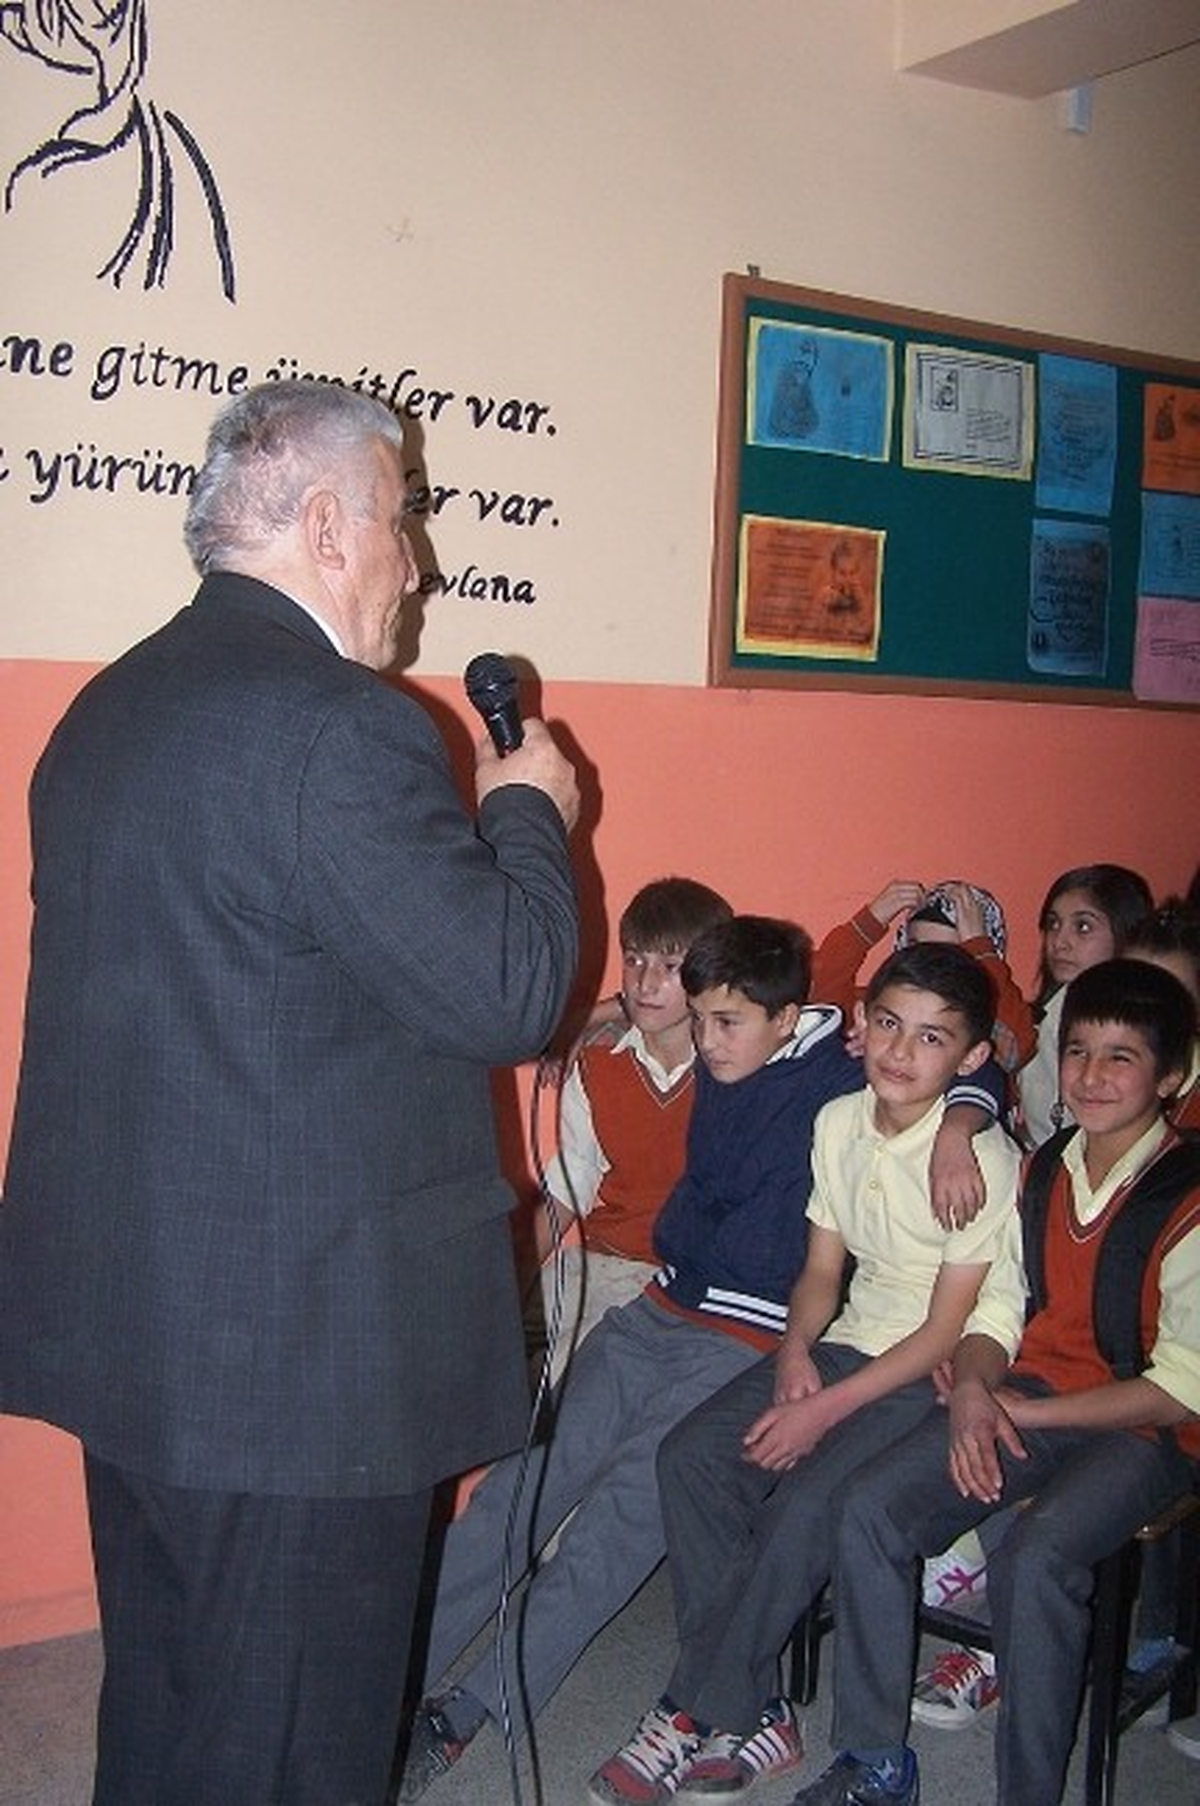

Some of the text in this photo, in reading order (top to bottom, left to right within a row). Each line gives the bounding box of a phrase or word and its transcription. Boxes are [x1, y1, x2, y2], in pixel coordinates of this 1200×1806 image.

[0, 336, 73, 376] ne
[91, 342, 248, 400] gitme
[465, 395, 556, 436] var.
[26, 443, 201, 503] yürüm
[468, 489, 559, 526] var.
[417, 565, 536, 604] evlana
